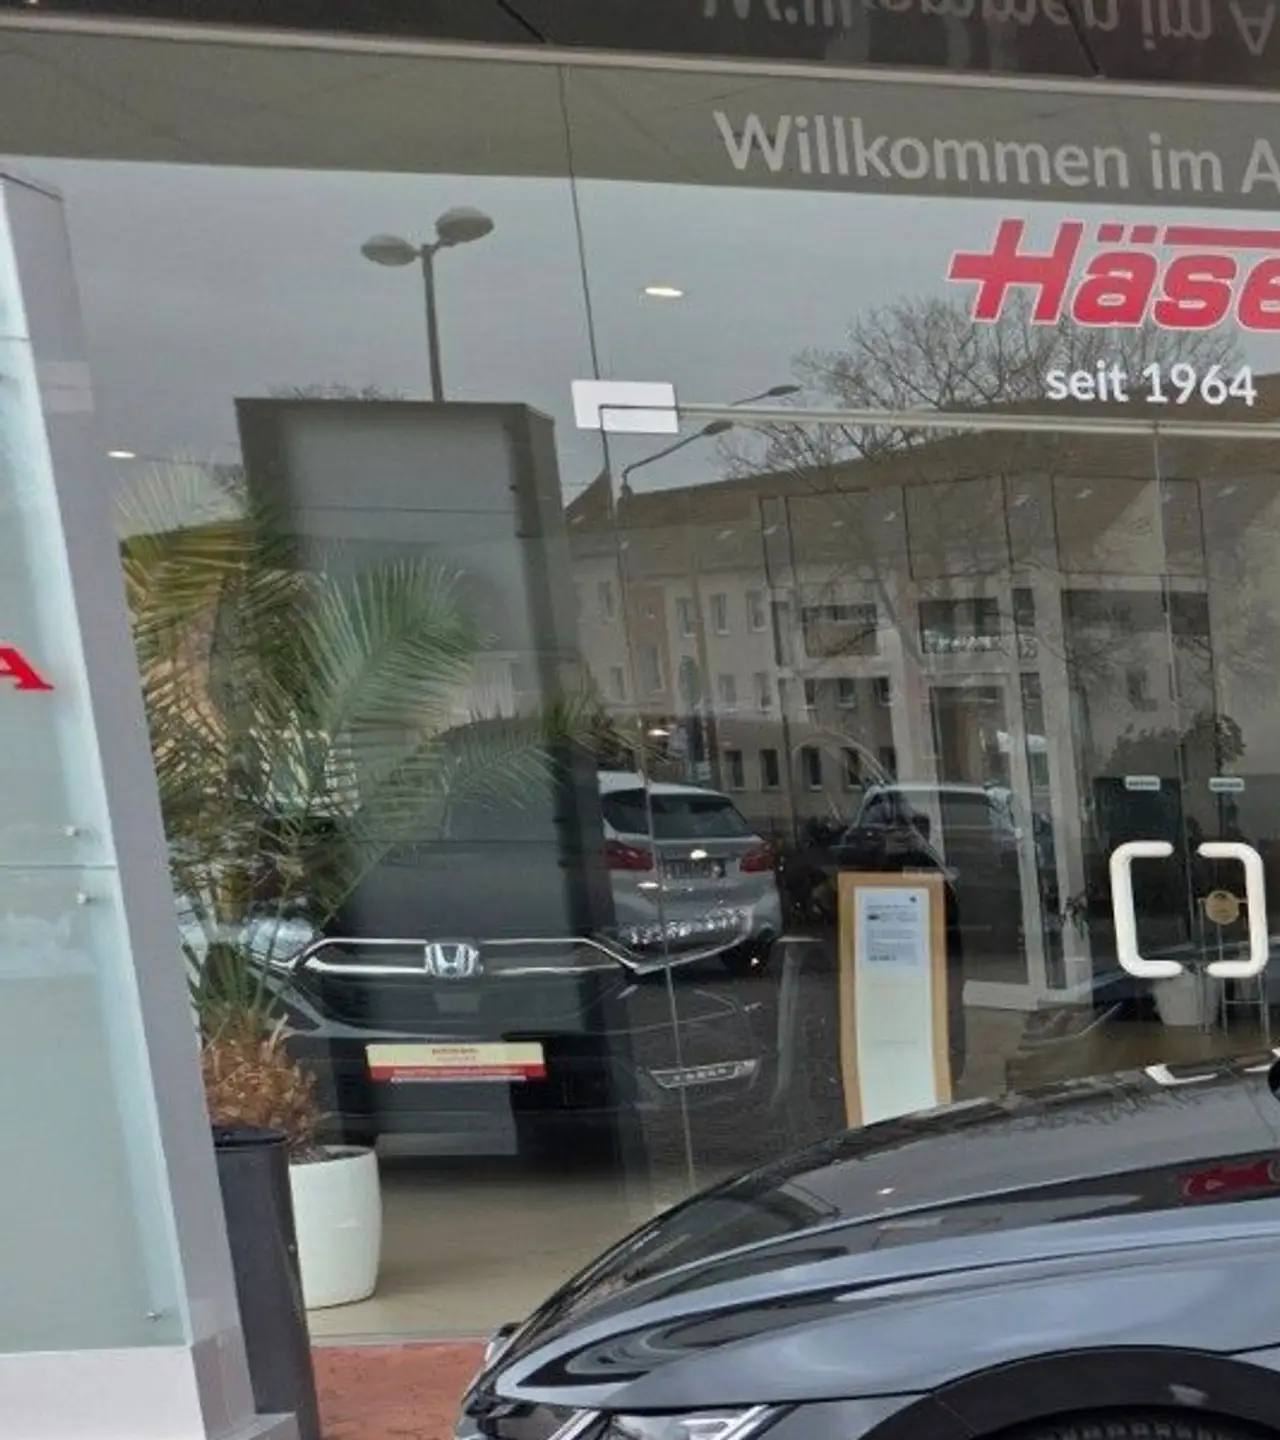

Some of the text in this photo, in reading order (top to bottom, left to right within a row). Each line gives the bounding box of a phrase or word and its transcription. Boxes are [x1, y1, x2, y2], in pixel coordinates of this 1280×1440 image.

[713, 110, 1130, 188] Willkommen
[1149, 132, 1223, 192] im
[1045, 360, 1257, 406] seit 1964
